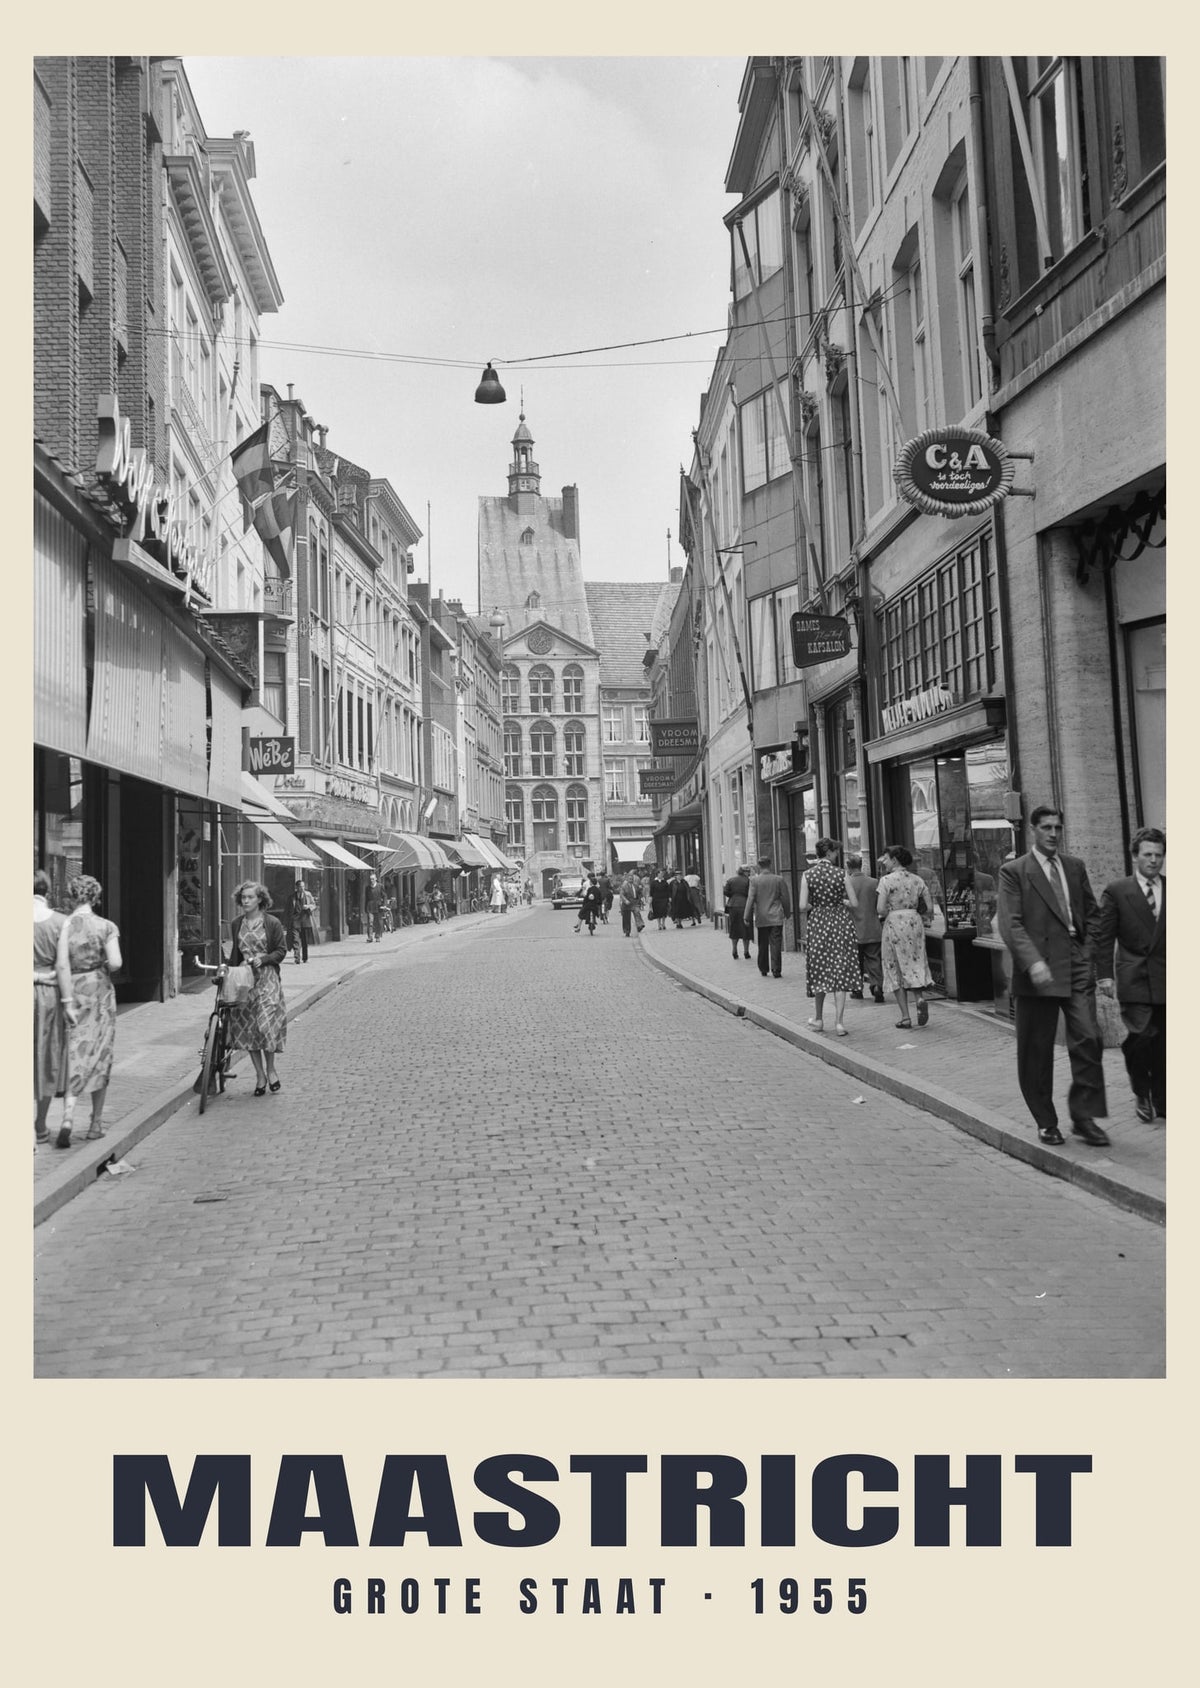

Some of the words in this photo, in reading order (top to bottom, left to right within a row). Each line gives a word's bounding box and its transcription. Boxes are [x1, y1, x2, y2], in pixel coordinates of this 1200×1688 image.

[926, 444, 991, 470] C&A
[948, 470, 972, 481] toch
[796, 619, 820, 632] DAMES
[808, 640, 845, 653] KAPSALON
[250, 739, 292, 771] WéBé
